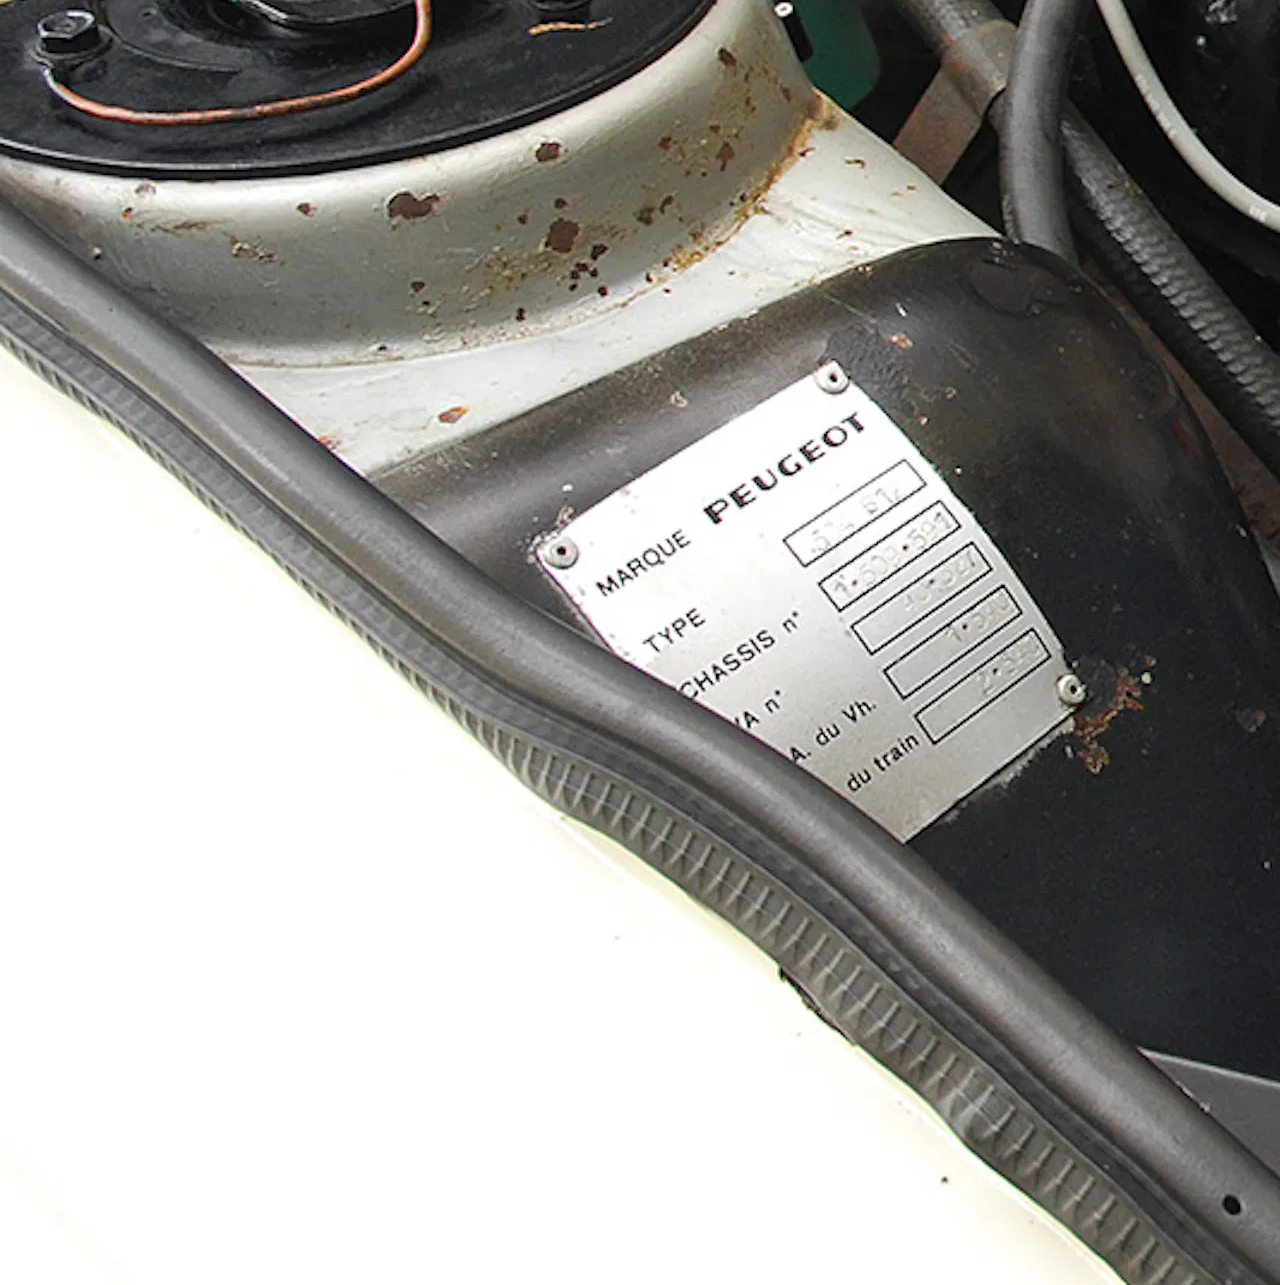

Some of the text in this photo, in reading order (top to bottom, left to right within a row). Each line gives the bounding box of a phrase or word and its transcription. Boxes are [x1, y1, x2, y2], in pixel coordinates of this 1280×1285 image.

[595, 528, 691, 597] MARQUE
[703, 411, 865, 525] PEUGEOT
[642, 607, 706, 653] TYPE
[679, 629, 776, 699] CHASSIS
[815, 722, 841, 747] du
[842, 698, 877, 724] Vh.
[846, 732, 920, 793] du train
